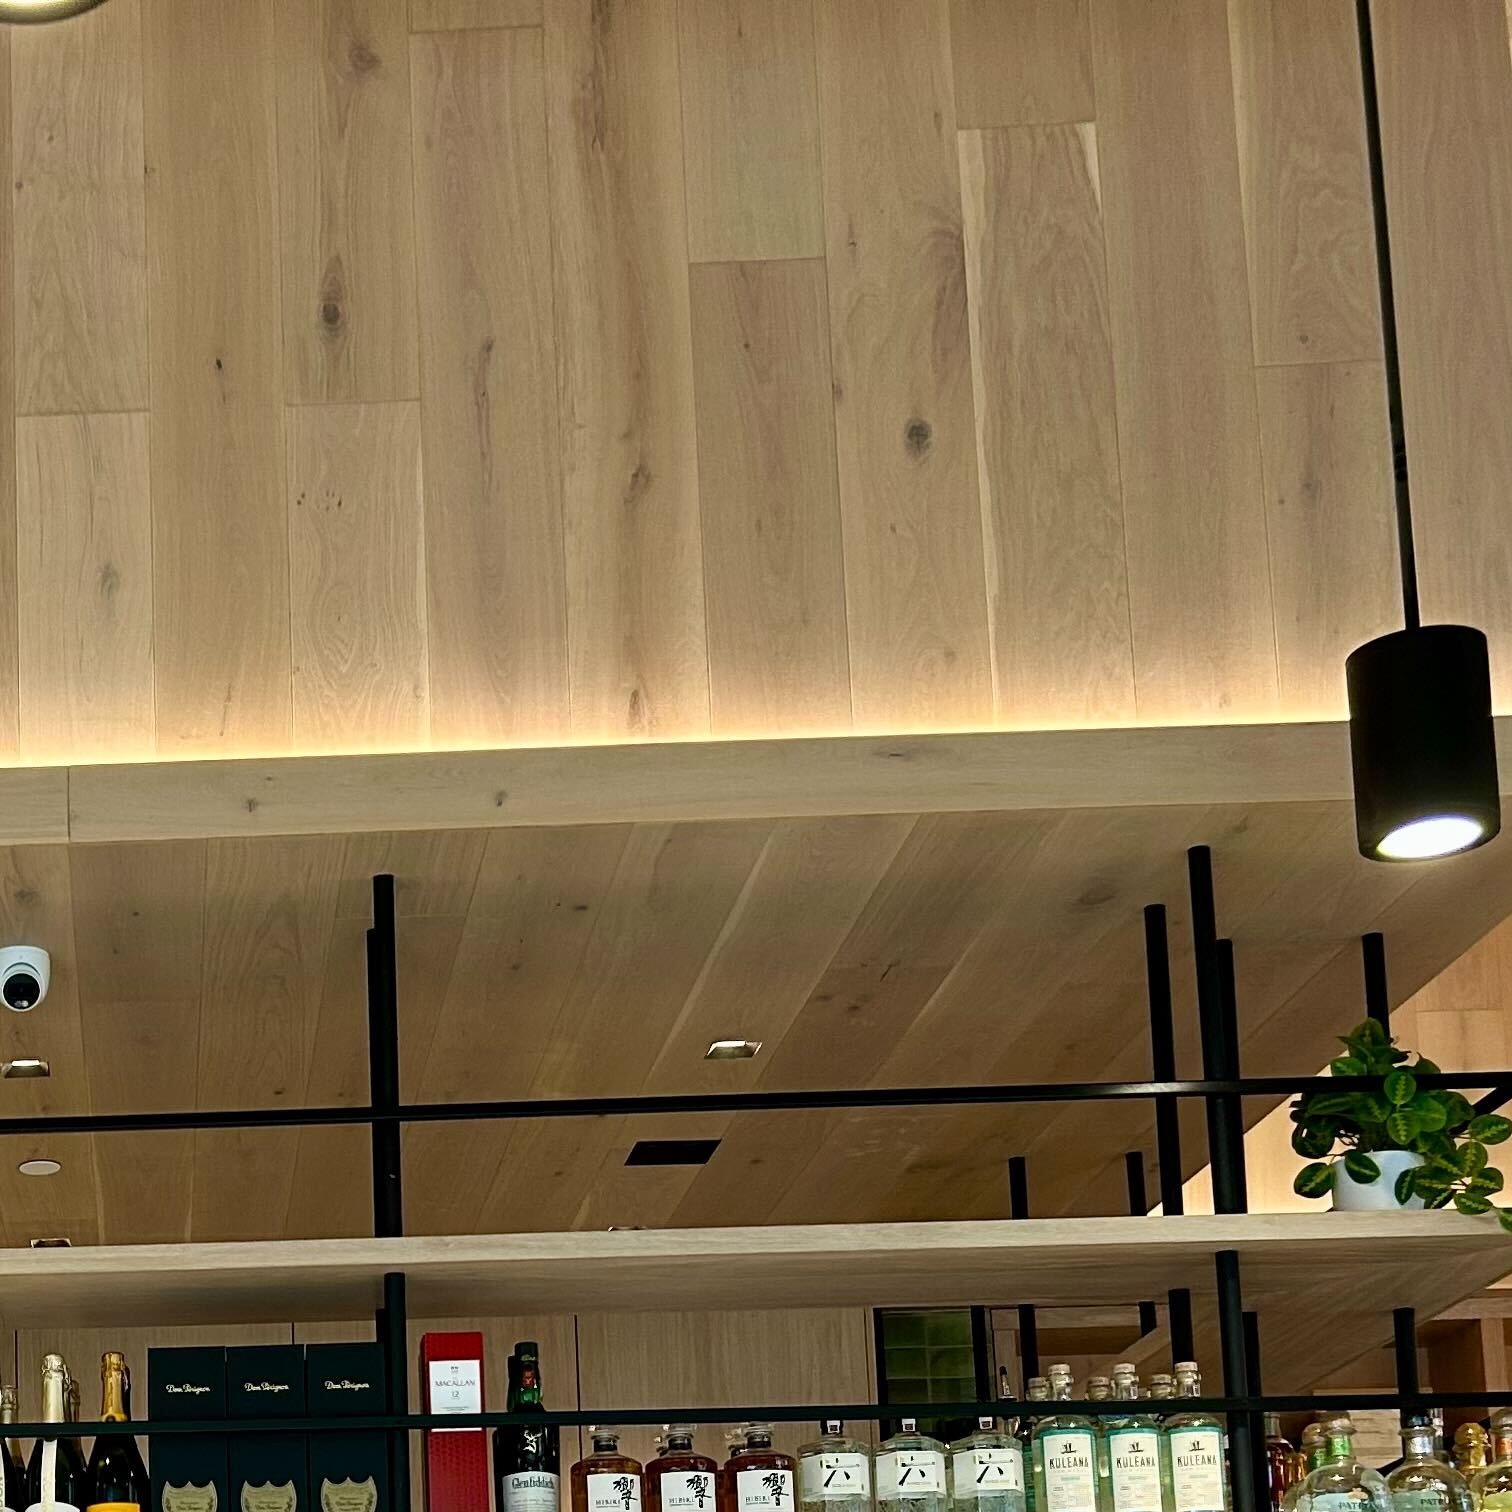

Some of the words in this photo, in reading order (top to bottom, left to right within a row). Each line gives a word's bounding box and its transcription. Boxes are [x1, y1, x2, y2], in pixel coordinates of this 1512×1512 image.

[1049, 1456, 1089, 1470] KULEANA
[1116, 1456, 1156, 1469] KULEANA
[1177, 1454, 1217, 1467] KULEANA
